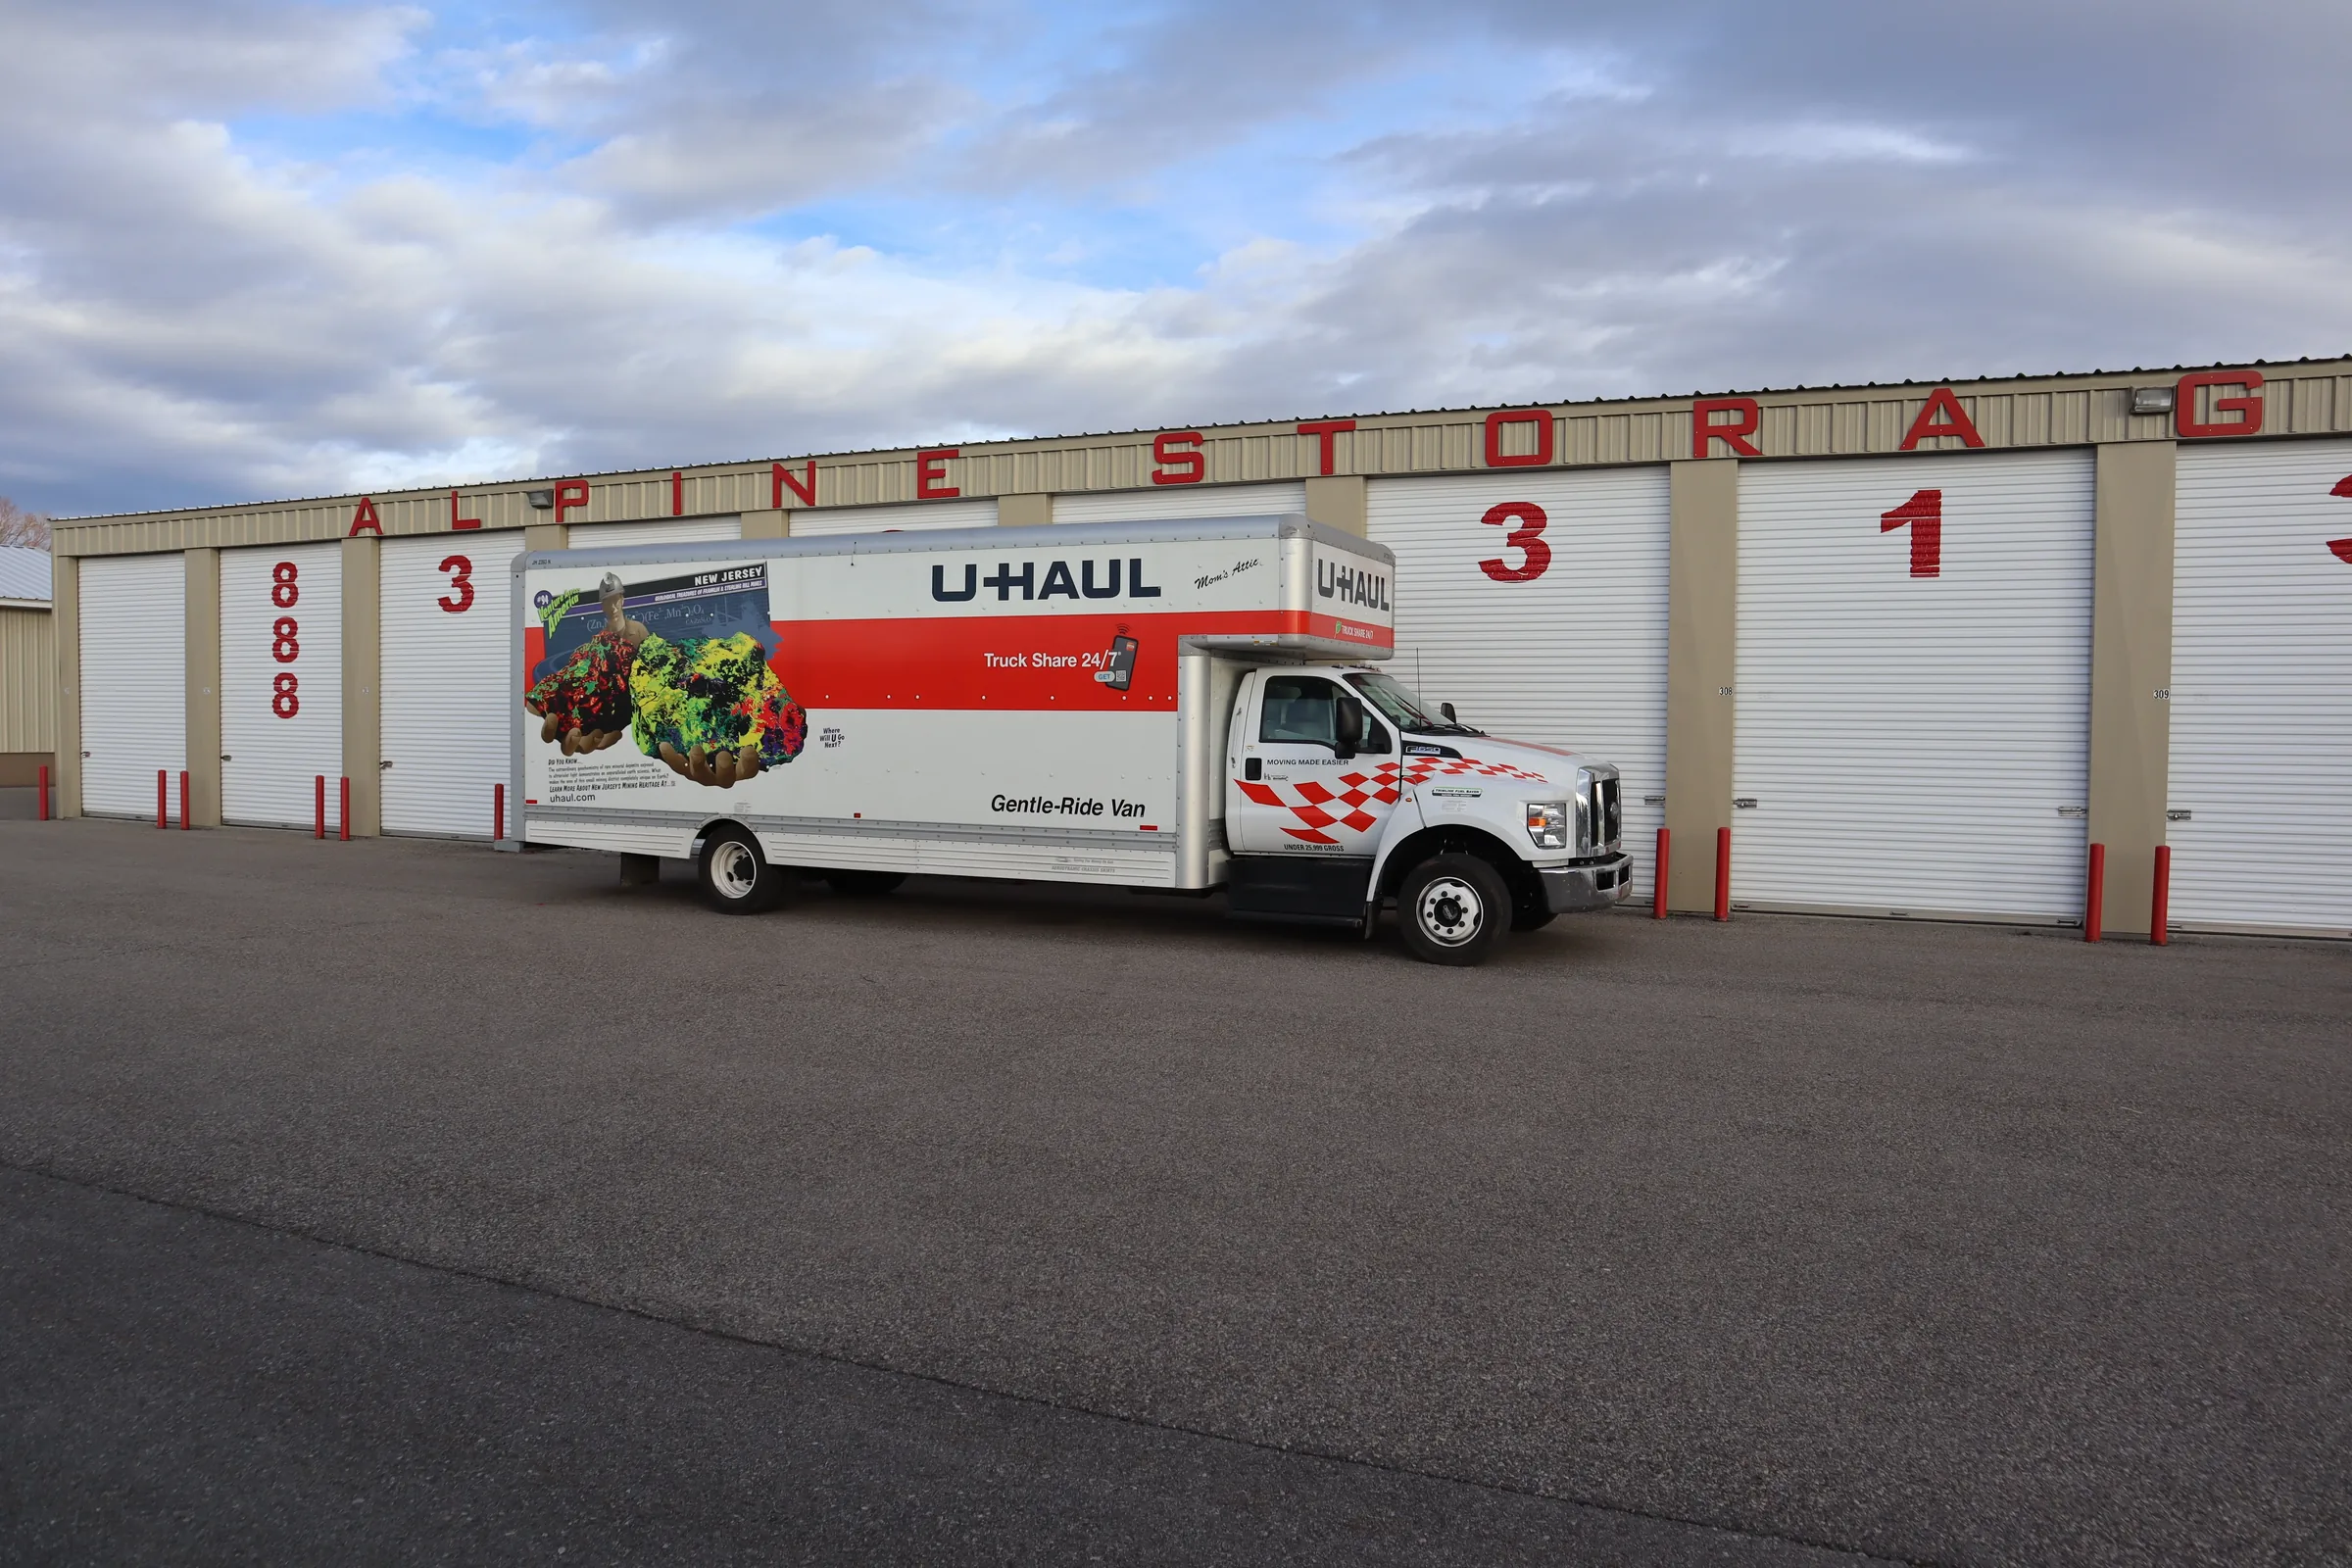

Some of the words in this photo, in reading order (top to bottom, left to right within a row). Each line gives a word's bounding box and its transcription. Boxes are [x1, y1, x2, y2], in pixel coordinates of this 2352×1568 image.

[1481, 501, 1552, 580] 3
[1881, 489, 1942, 577] 1
[439, 555, 474, 612] 3
[694, 573, 718, 586] NEW
[721, 565, 762, 582] JERSEY
[1195, 569, 1229, 590] Mom's
[1232, 558, 1258, 576] Attic
[538, 594, 564, 622] Venture
[548, 594, 579, 639] America
[1341, 624, 1353, 636] TRUCK
[1353, 626, 1366, 639] SHARE
[983, 653, 1028, 668] Truck
[1032, 652, 1078, 668] Share
[1719, 686, 1733, 696] 308
[2153, 689, 2170, 700] 309
[831, 734, 837, 743] U
[550, 793, 596, 803] uhaul.com
[991, 794, 1104, 816] Gentle-Ride
[1111, 799, 1146, 817] Van
